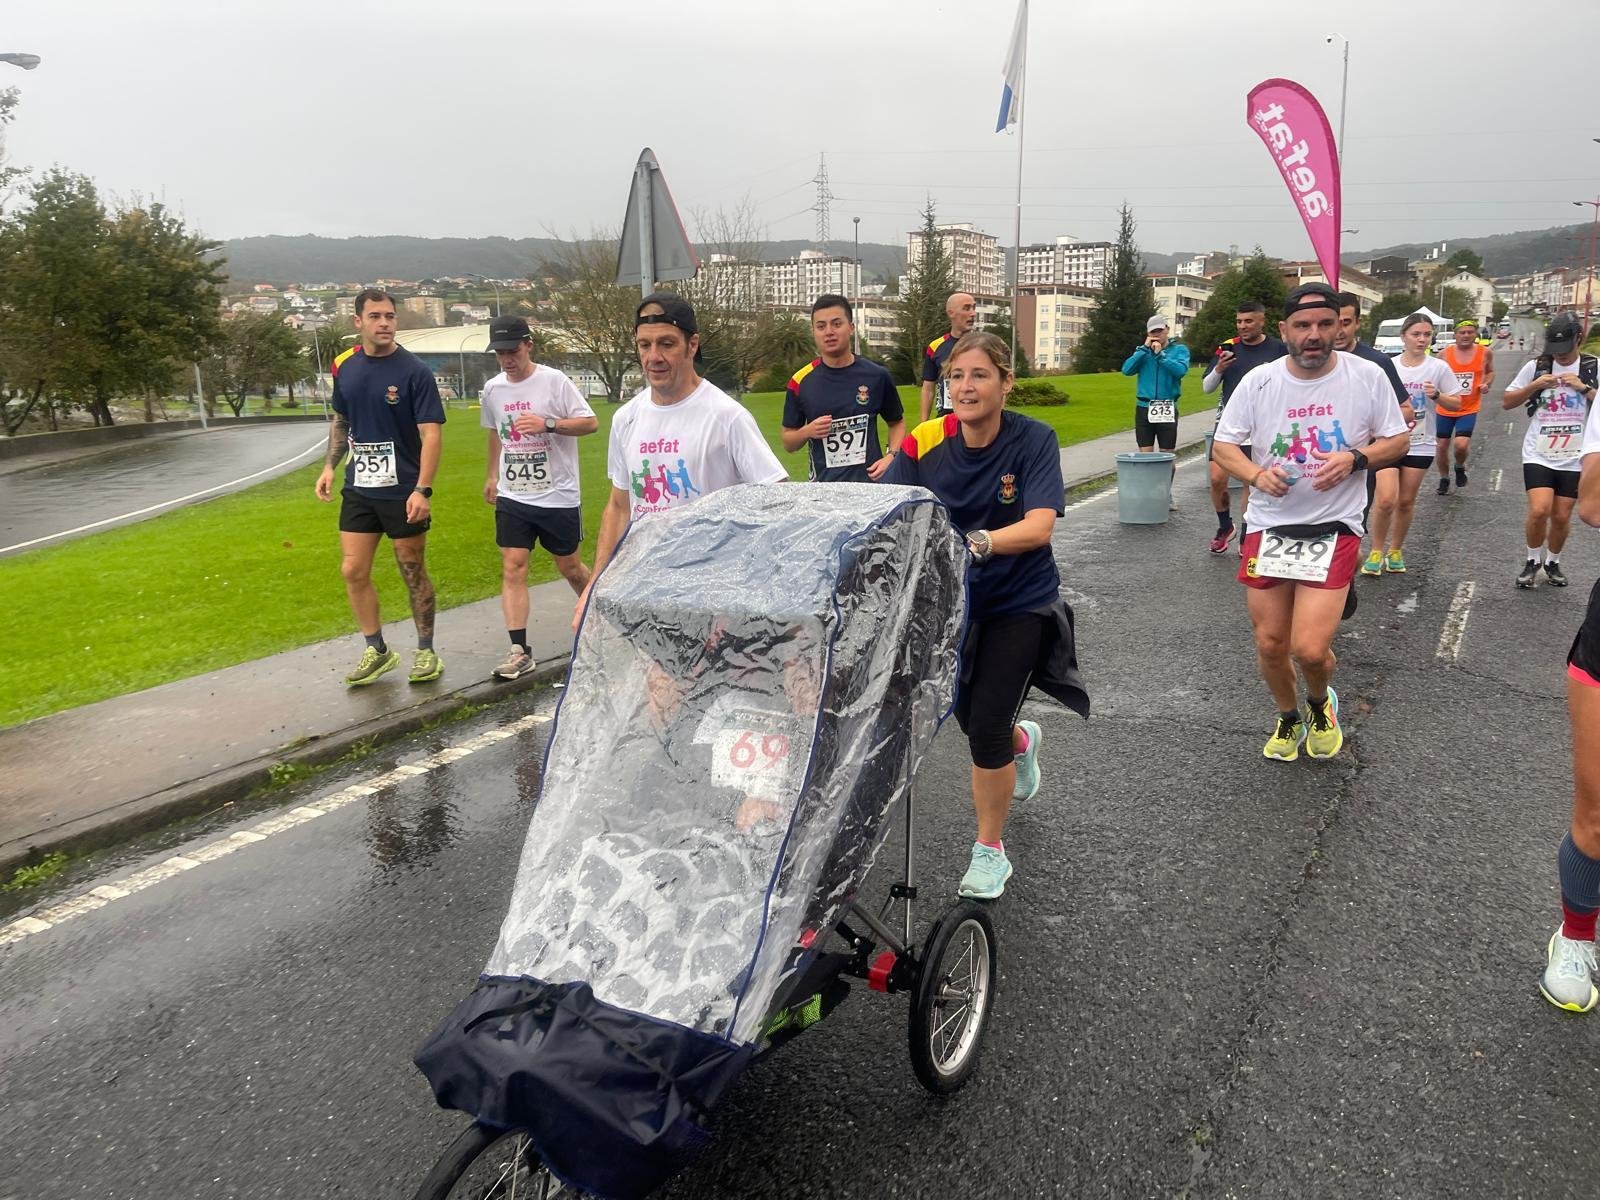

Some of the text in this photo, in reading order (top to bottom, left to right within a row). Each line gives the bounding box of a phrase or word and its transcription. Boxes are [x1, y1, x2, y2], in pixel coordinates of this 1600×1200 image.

[1404, 381, 1424, 390] efat
[504, 401, 532, 412] aefat
[1150, 406, 1171, 416] 613
[1287, 403, 1334, 419] aefat
[640, 438, 679, 454] aefat
[826, 429, 866, 453] 597
[1547, 434, 1571, 449] 77
[355, 455, 389, 473] 651
[506, 463, 547, 481] 645
[1262, 535, 1329, 562] 249
[729, 731, 790, 770] 69
